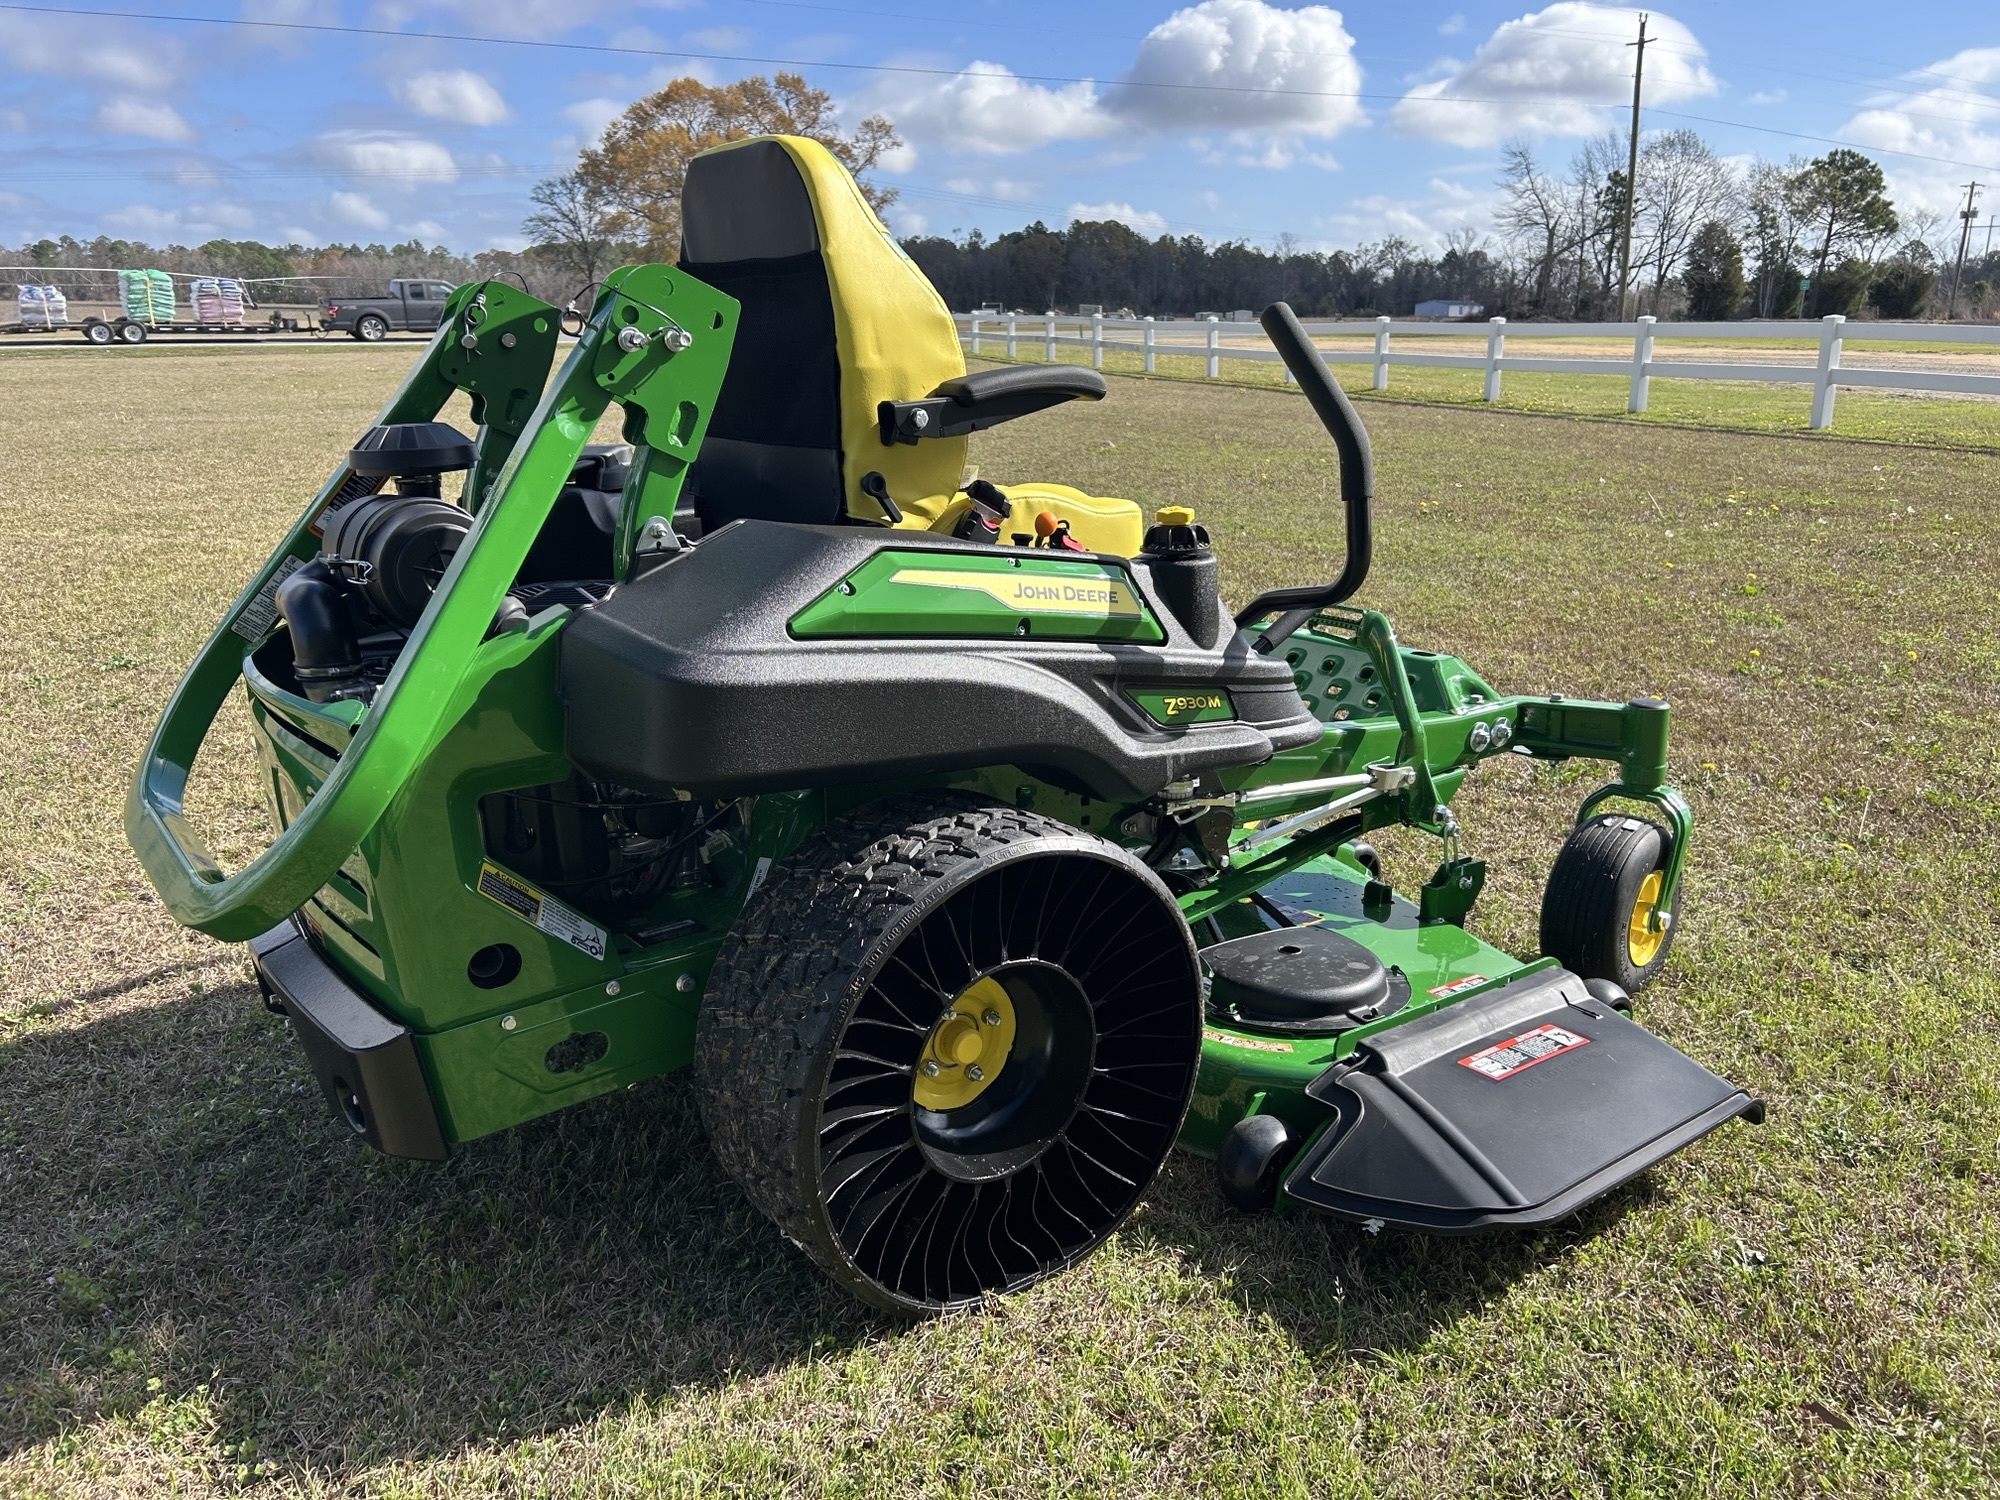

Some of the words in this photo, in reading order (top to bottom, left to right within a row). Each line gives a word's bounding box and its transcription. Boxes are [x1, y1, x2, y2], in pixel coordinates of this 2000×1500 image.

[1014, 583, 1060, 600] JOHN
[1063, 586, 1119, 603] DEERE
[1164, 696, 1221, 715] Z930M
[501, 874, 530, 894] CAUTION
[865, 945, 885, 968] NOT
[882, 927, 901, 947] FOR
[899, 892, 936, 928] HIGHWAY
